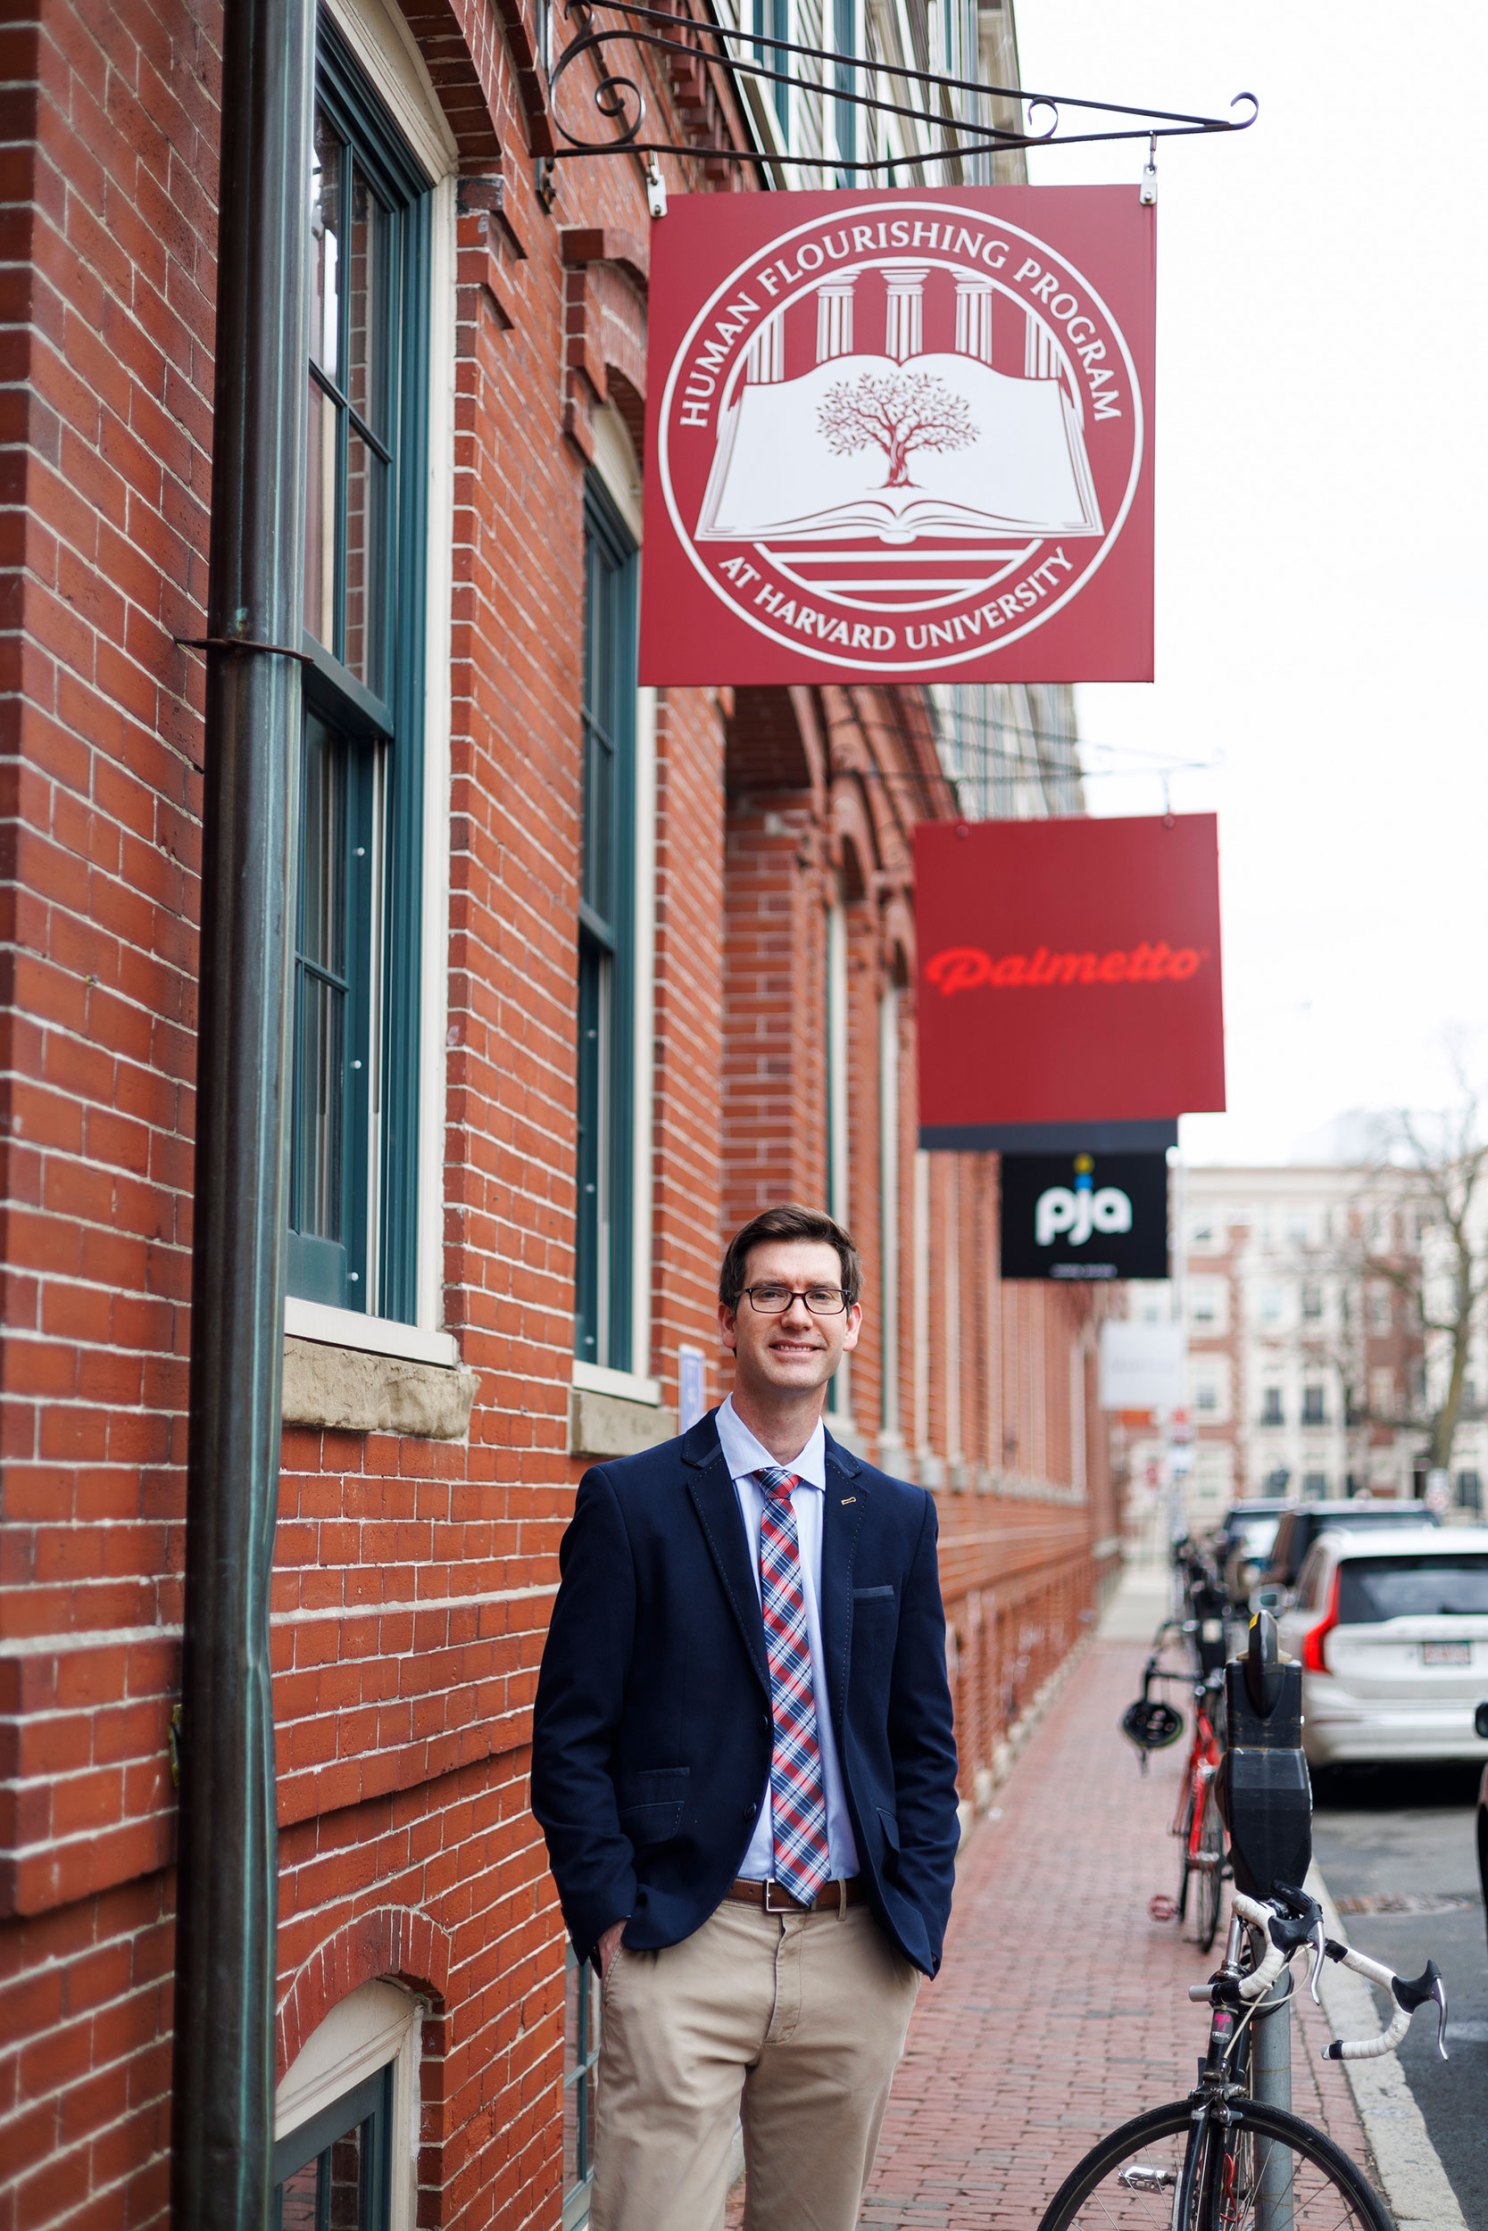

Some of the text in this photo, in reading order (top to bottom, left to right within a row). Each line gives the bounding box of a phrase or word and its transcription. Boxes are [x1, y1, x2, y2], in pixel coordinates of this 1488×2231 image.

[680, 220, 1122, 427] HUMAN FLOURISHING PROGRAM
[719, 546, 1074, 651] AT HARVARD UNIVERSITY
[924, 940, 1201, 997] Palmetto
[1036, 1153, 1132, 1246] pja
